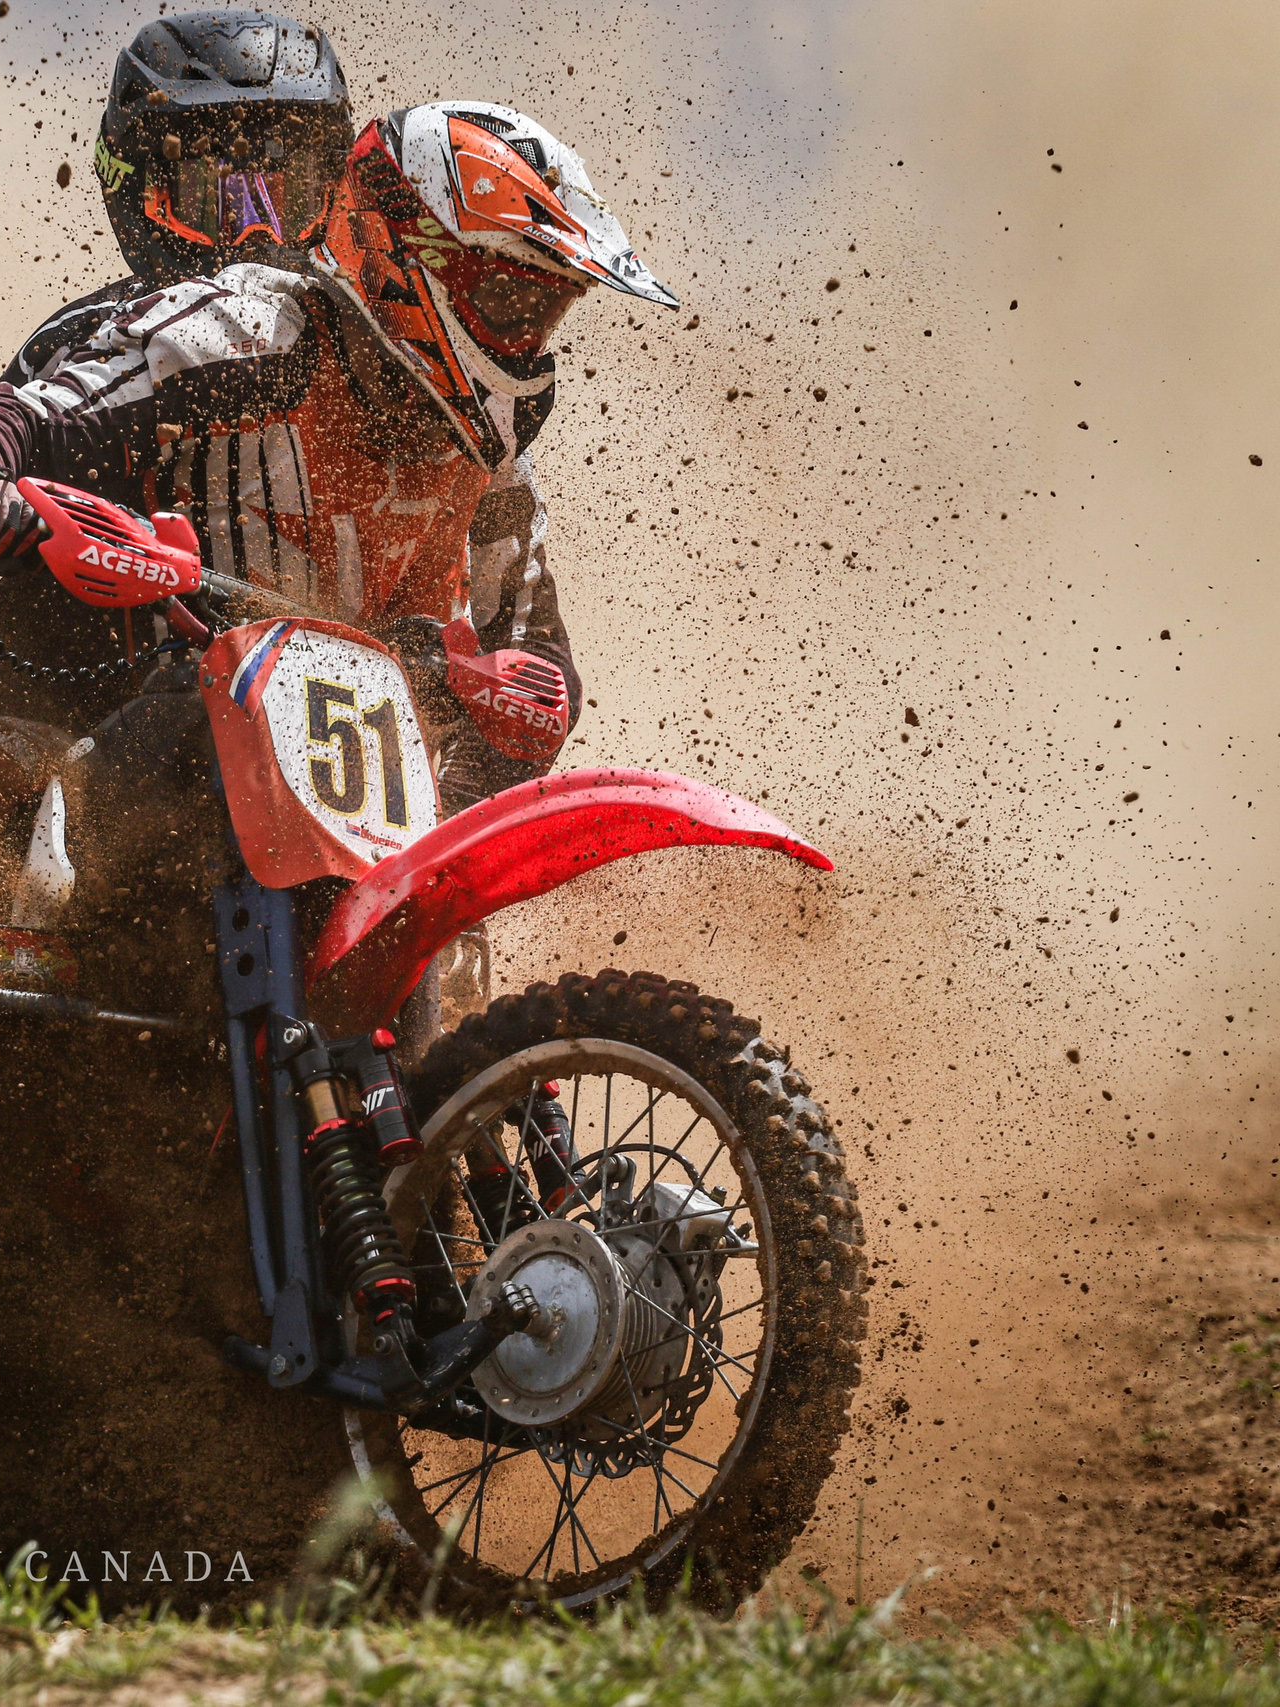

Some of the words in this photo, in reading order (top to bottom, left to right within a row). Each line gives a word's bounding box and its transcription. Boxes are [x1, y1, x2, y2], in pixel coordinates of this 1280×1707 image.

[227, 338, 266, 354] 360
[304, 675, 411, 832] 51
[360, 827, 403, 851] Boyesen
